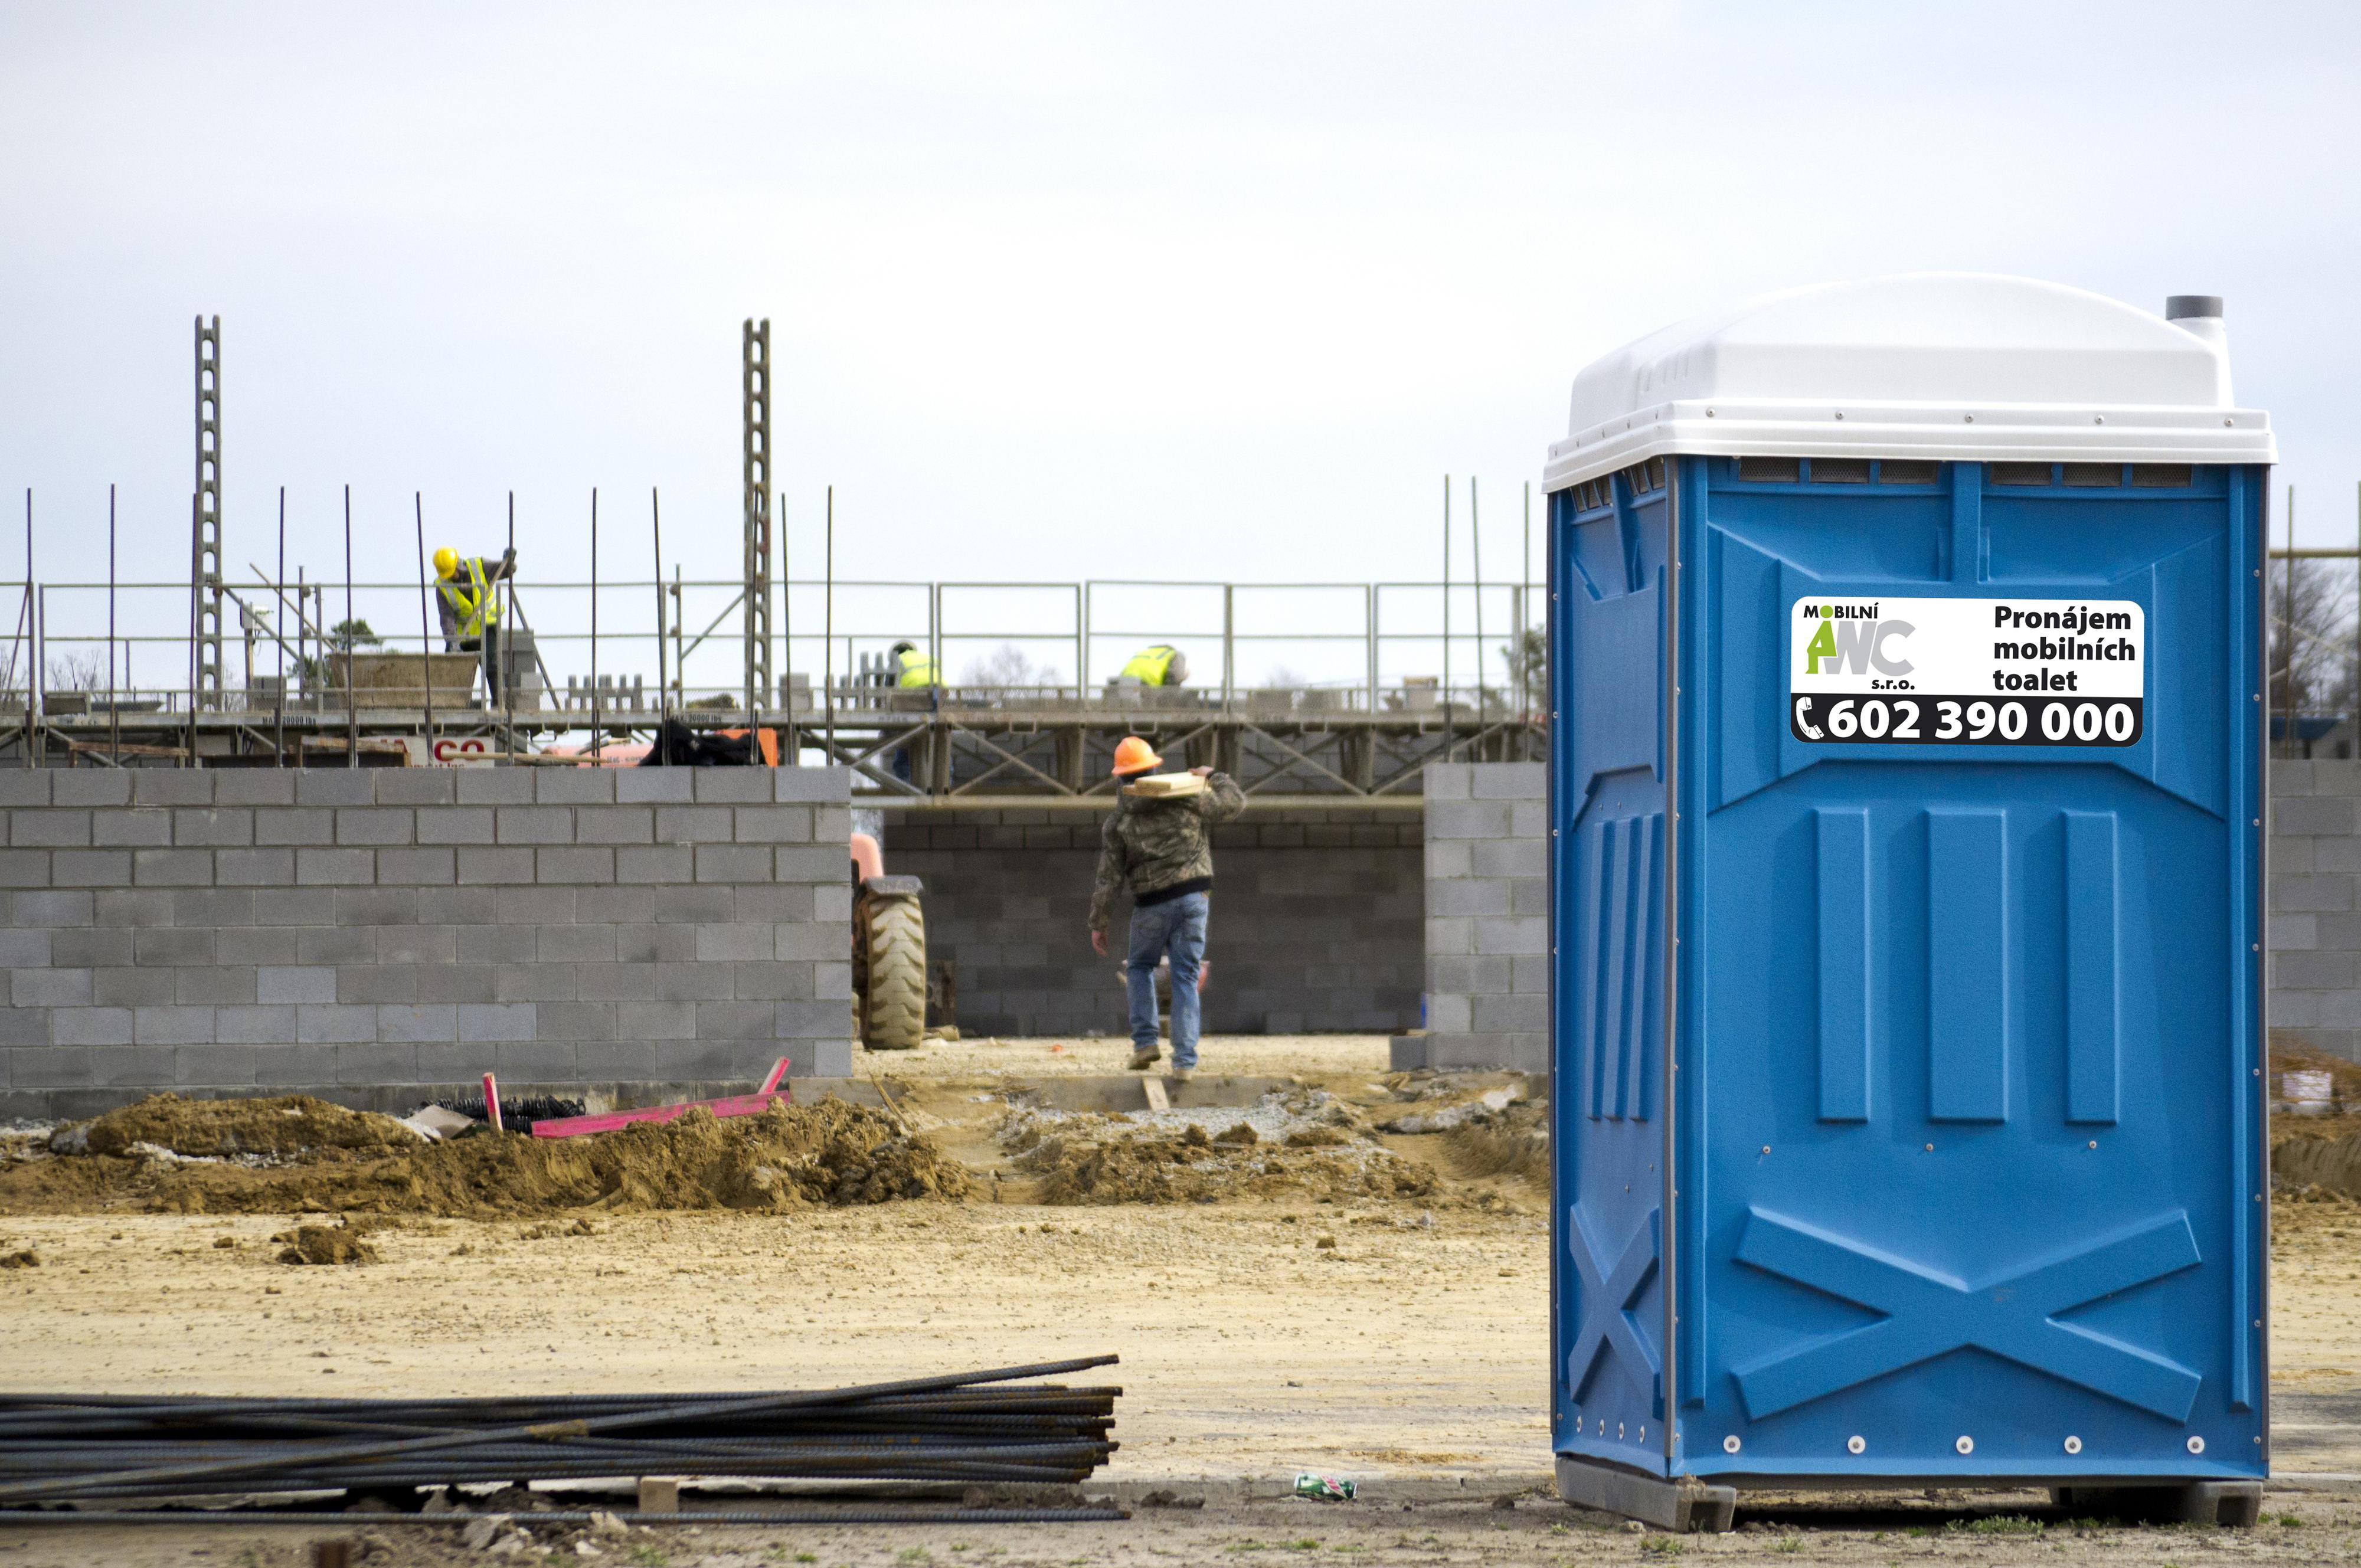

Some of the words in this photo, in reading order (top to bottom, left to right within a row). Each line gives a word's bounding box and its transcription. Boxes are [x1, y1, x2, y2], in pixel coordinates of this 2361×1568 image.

[1804, 602, 1879, 618] MOBILNÍ
[1995, 606, 2131, 635] Pronájem
[1994, 637, 2136, 660] mobilních
[1872, 680, 1915, 689] s.r.o.
[1993, 668, 2077, 691] toalet
[1829, 700, 1920, 738] 602
[1935, 701, 2028, 739] 390
[2042, 703, 2134, 741] 000
